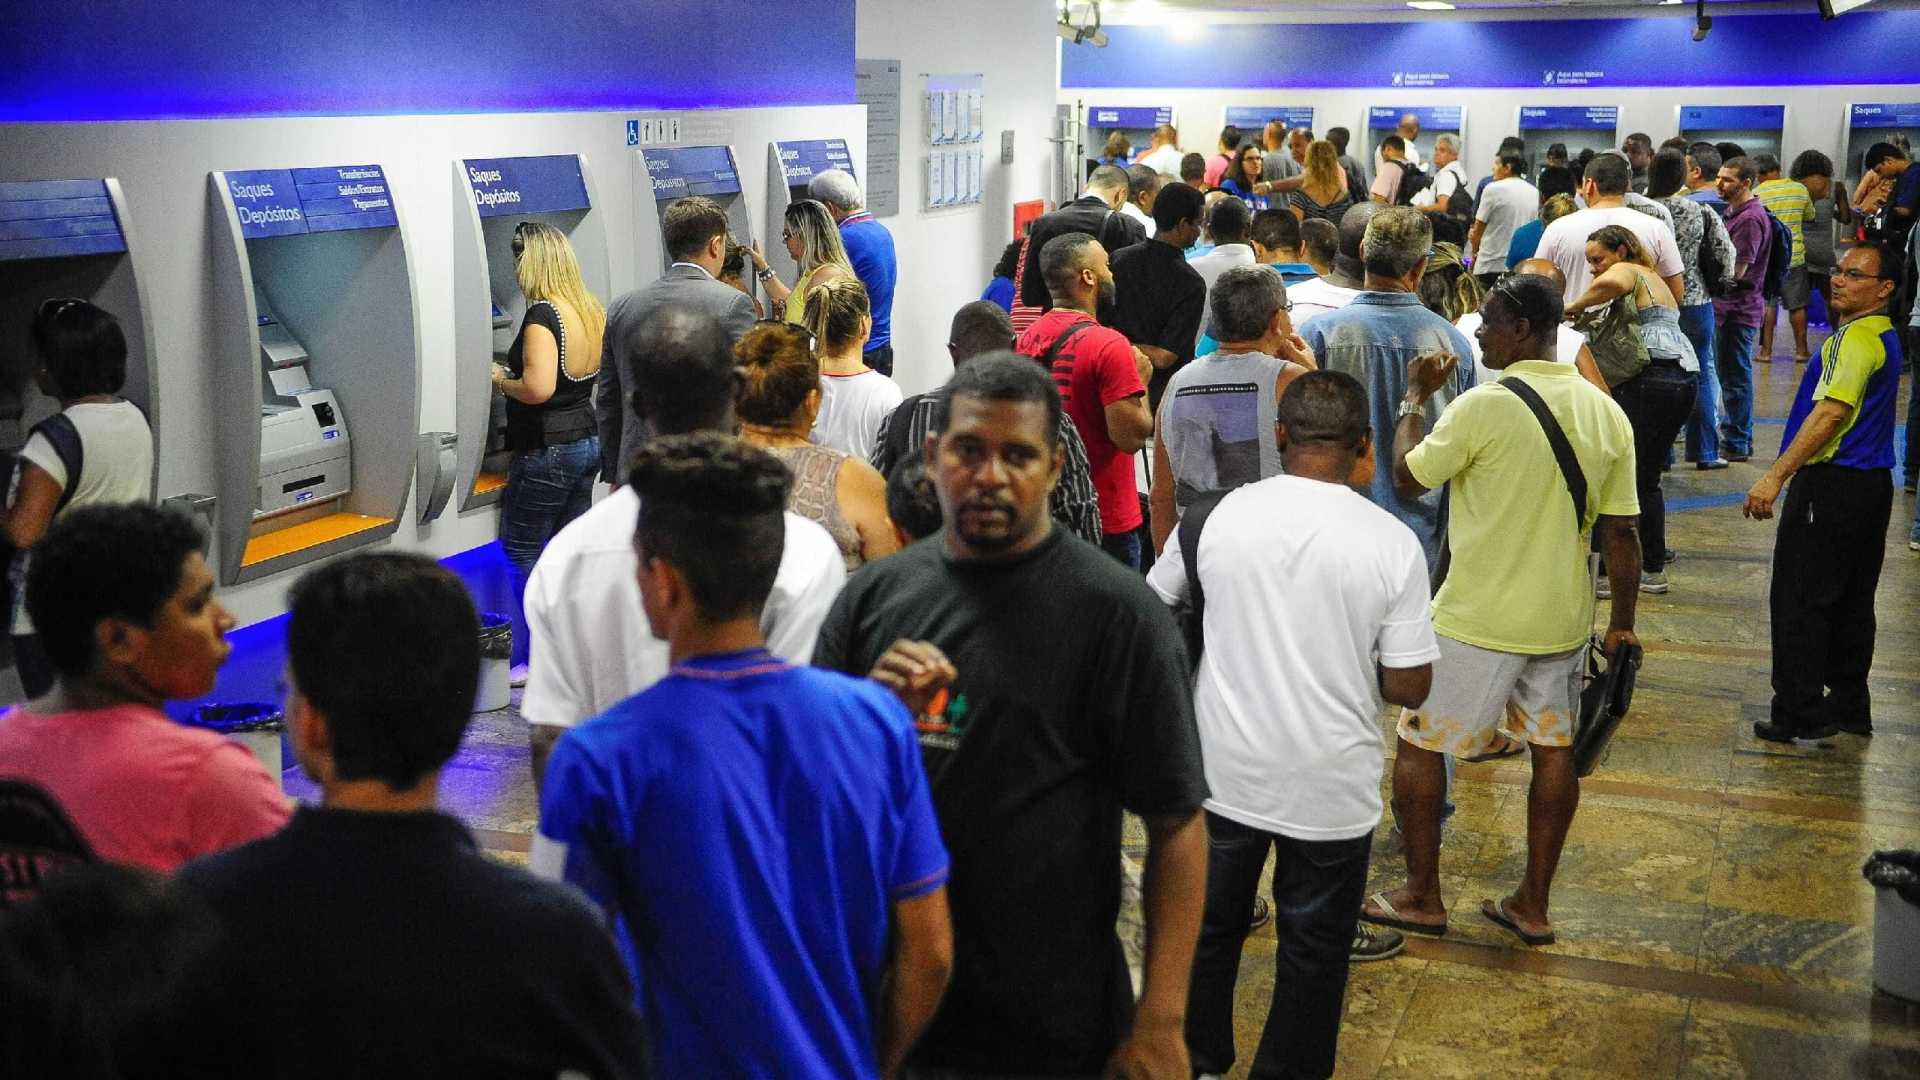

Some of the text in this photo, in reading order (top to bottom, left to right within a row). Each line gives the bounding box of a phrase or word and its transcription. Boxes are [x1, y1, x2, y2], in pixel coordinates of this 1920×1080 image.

[1855, 106, 1881, 115] Saques
[469, 167, 502, 187] Saques
[231, 180, 274, 203] Saques
[474, 188, 521, 209] Depósitos
[237, 205, 301, 228] Depósitos
